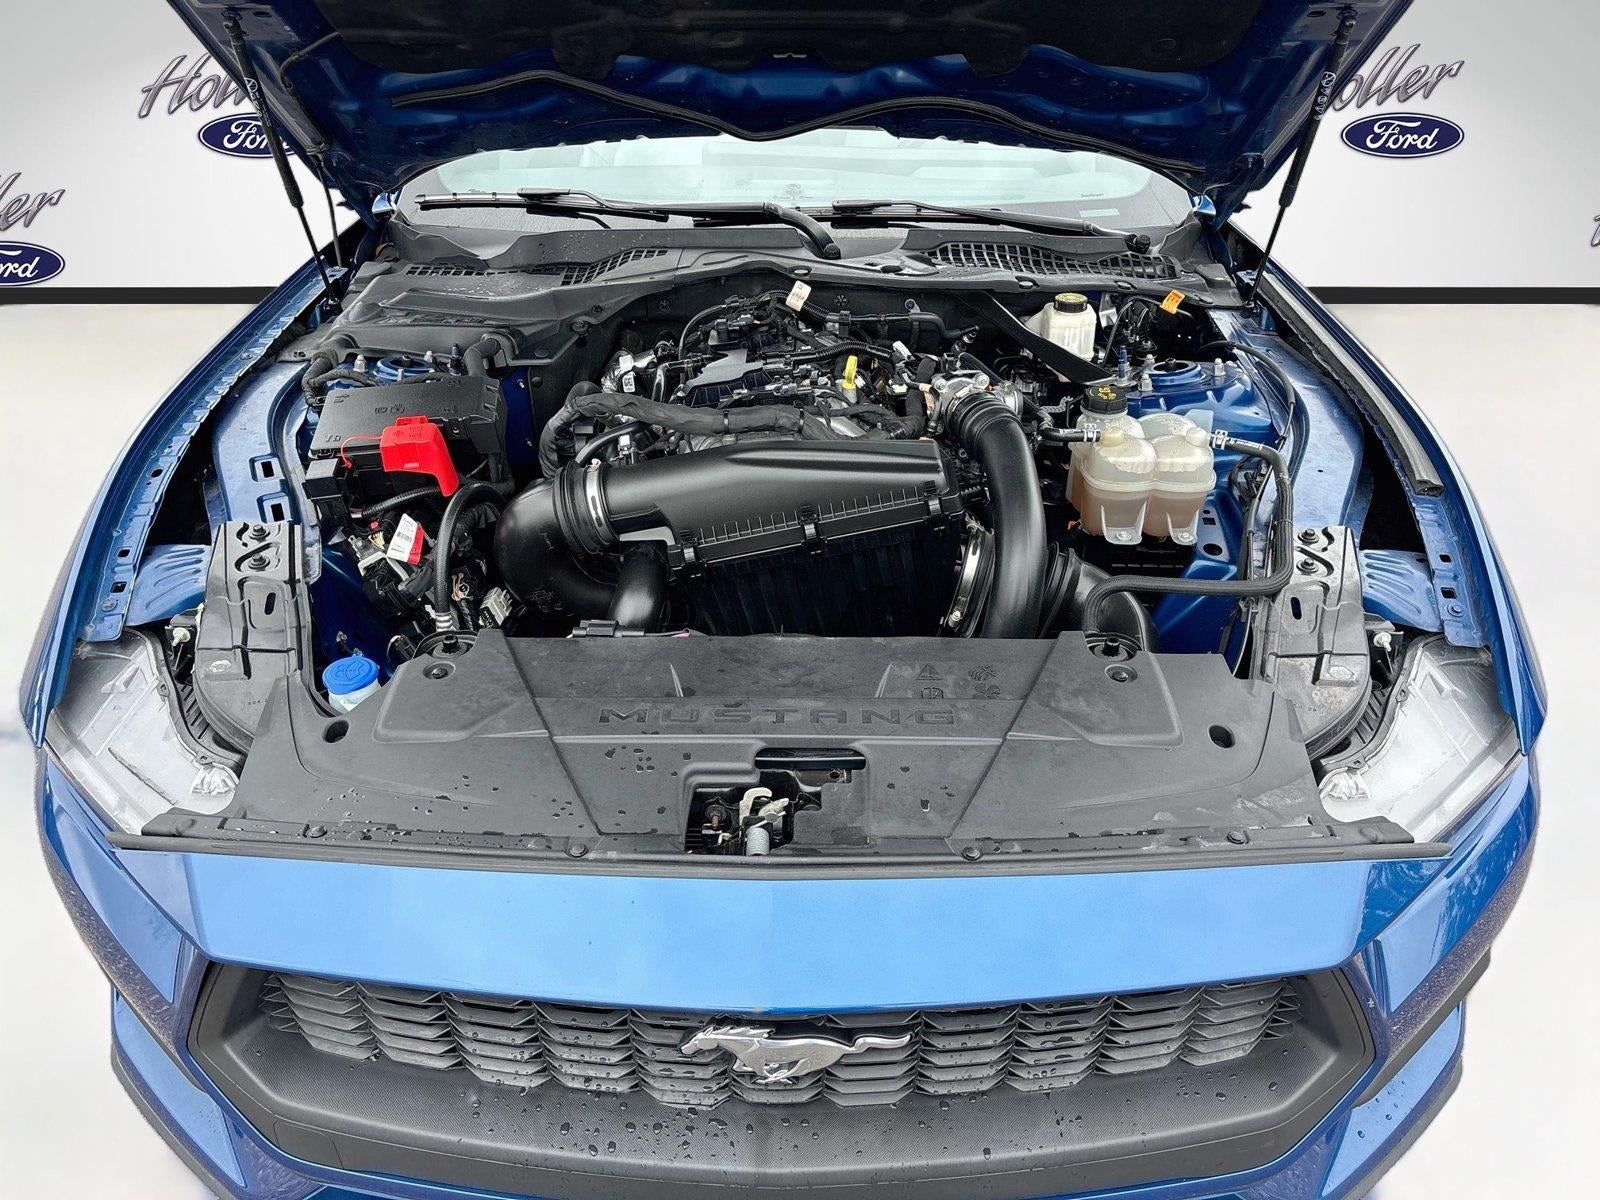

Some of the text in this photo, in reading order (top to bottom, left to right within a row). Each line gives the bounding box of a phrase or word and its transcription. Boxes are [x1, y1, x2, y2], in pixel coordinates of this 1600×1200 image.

[1332, 43, 1465, 112] oller
[1366, 119, 1440, 149] Ford
[599, 707, 956, 725] MUSTANG
